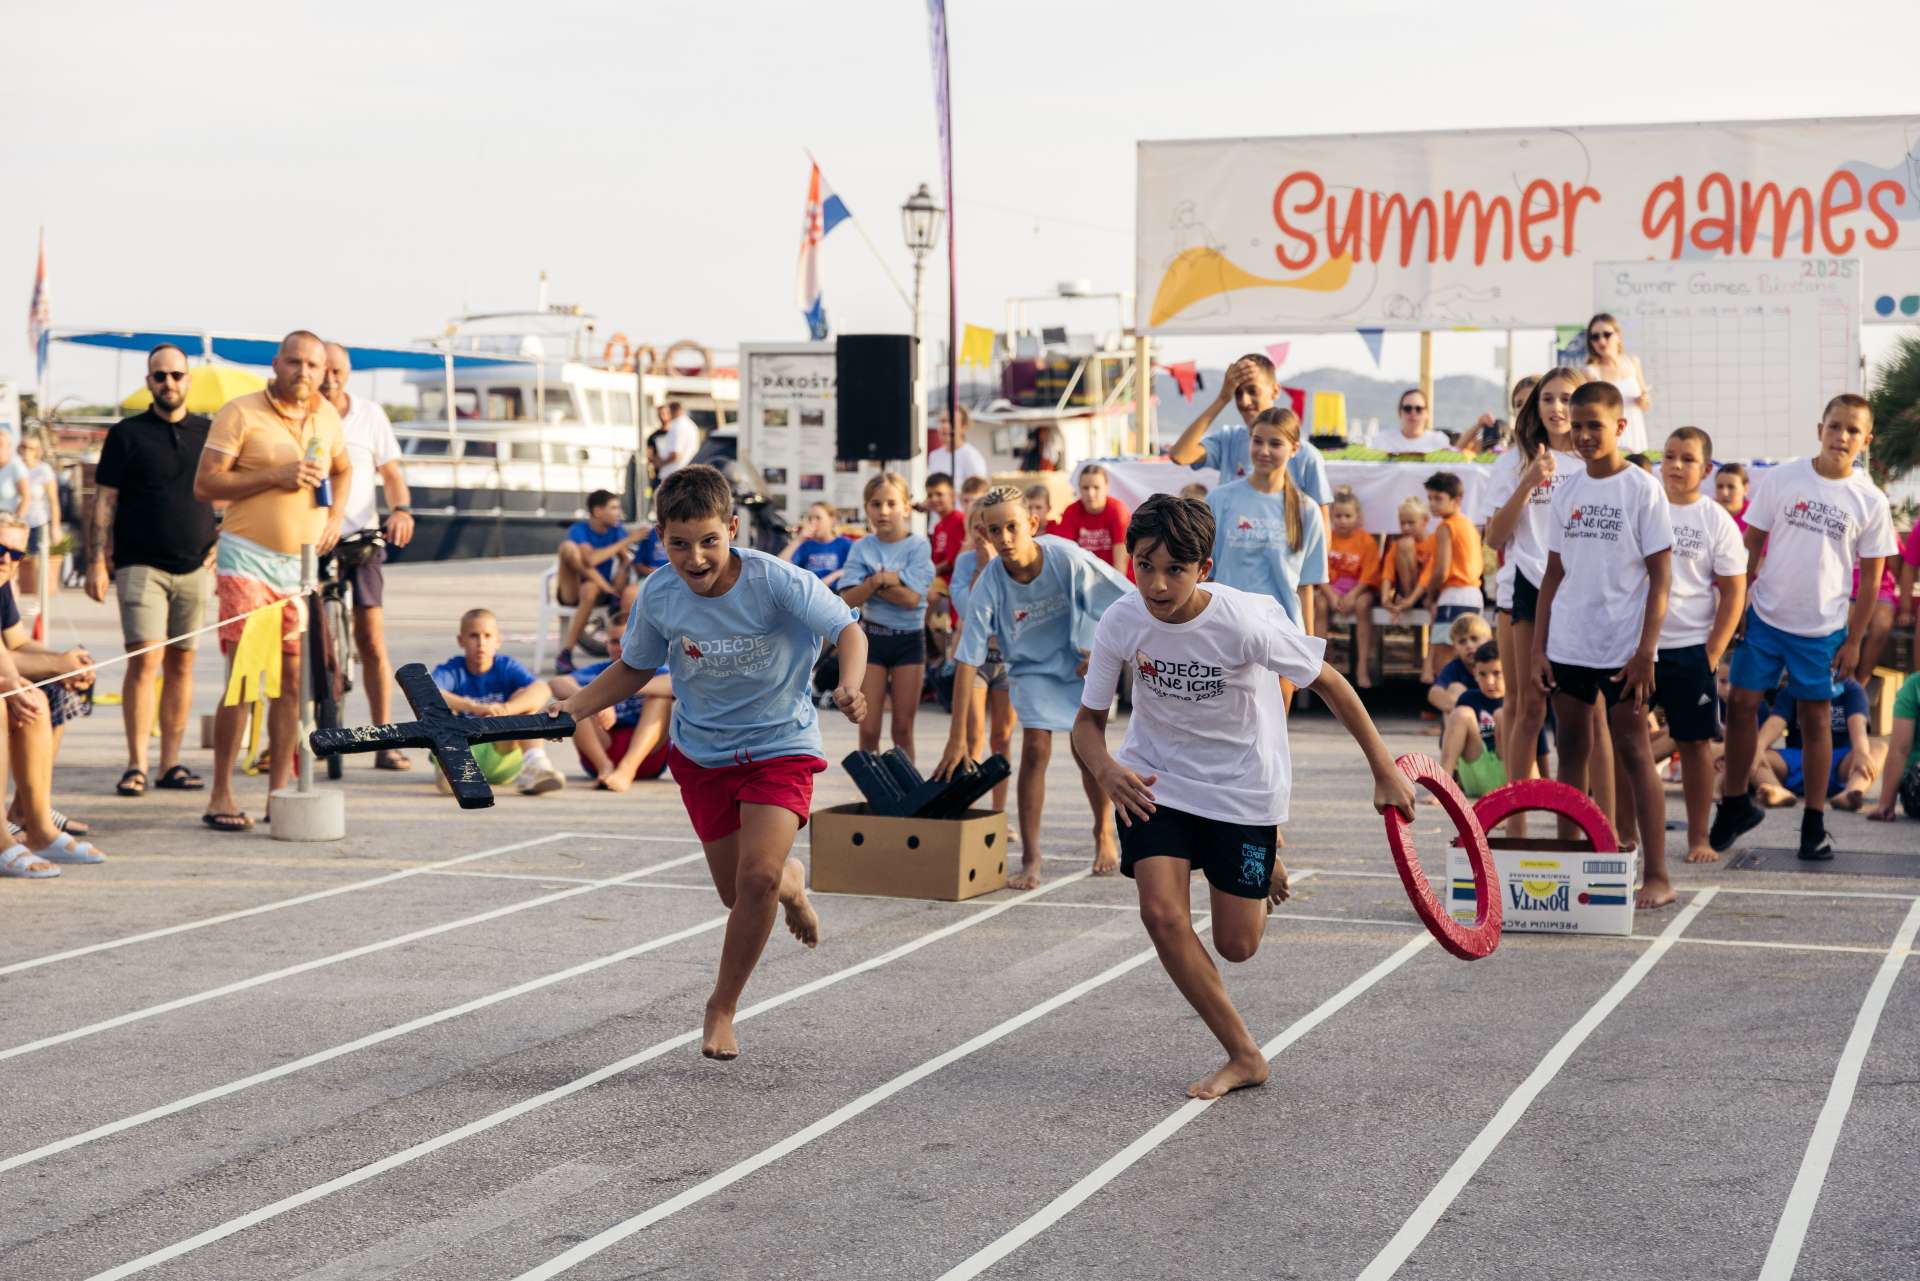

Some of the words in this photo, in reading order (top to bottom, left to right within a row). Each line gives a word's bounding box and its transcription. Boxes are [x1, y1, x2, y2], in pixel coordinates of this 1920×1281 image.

[1272, 170, 1601, 270] Summer
[1642, 169, 1905, 263] games
[1803, 260, 1856, 279] 2025
[1580, 504, 1623, 519] DJEČJE
[1597, 519, 1624, 532] IGRE
[1599, 532, 1619, 541] 2025
[699, 635, 769, 655] DJEČJE
[1155, 659, 1222, 679] DJEČJE
[1187, 678, 1227, 692] IGRE
[1196, 687, 1224, 702] 2025
[1509, 883, 1570, 912] BONITA
[1530, 920, 1578, 930] PREMIUM
